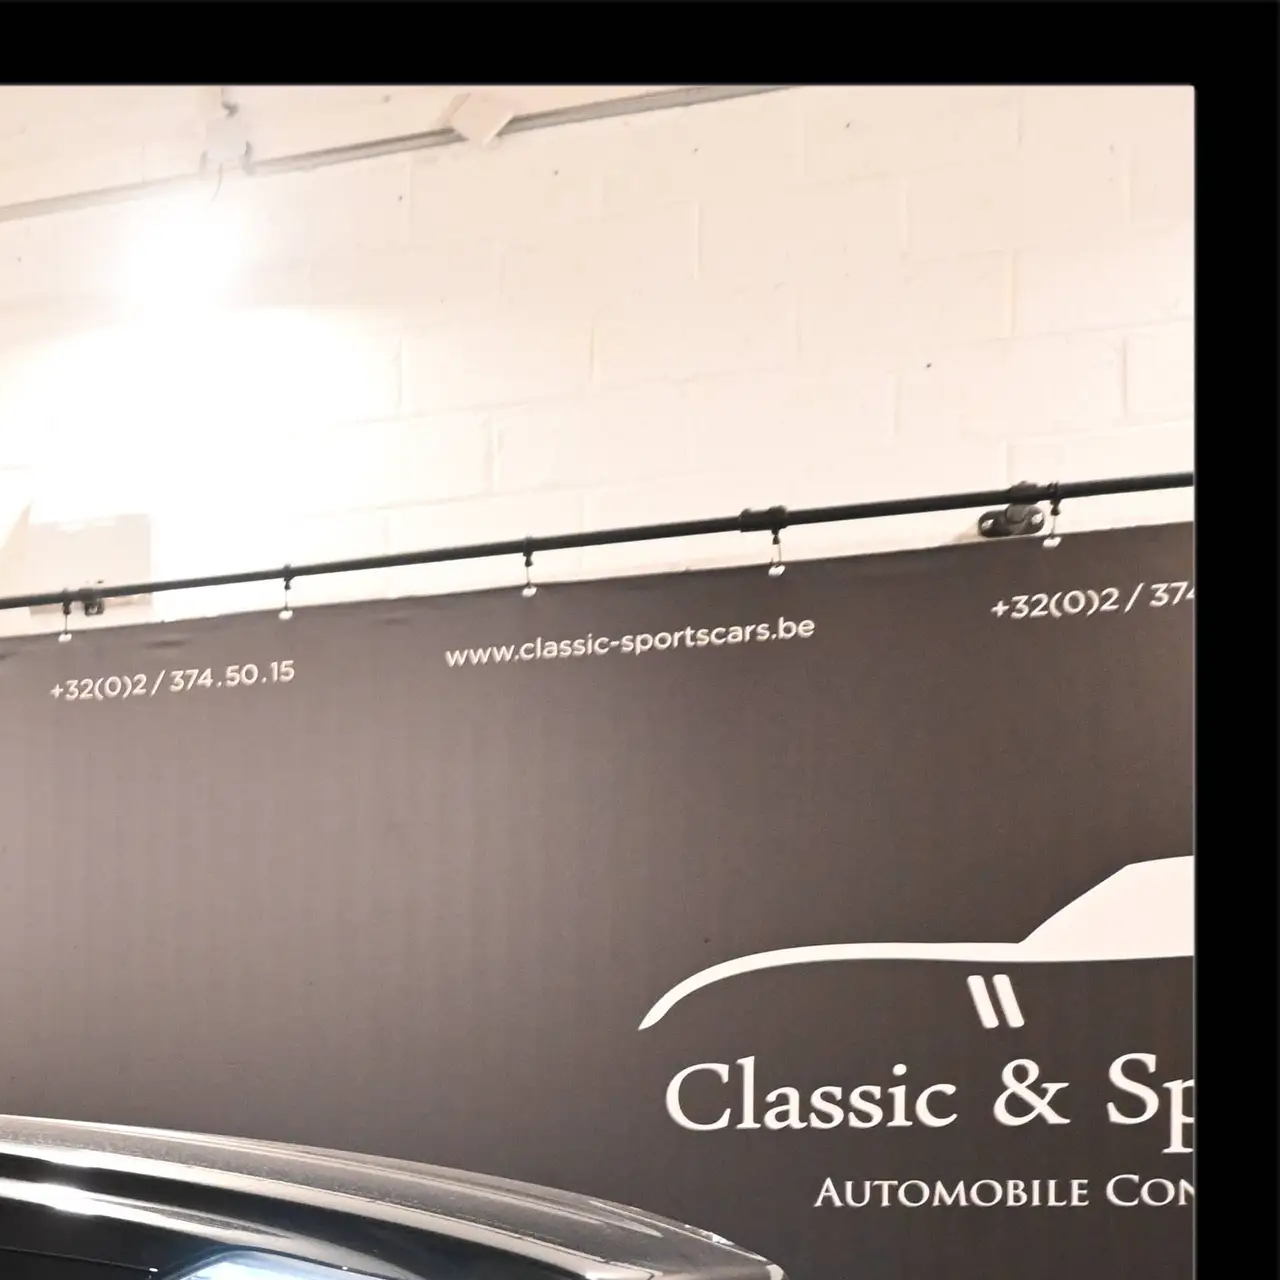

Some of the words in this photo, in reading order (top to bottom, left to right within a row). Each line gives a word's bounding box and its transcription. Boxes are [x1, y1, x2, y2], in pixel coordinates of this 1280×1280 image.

[990, 588, 1120, 620] +32(0)2
[445, 616, 816, 669] www.classic-sportscars.be
[50, 673, 147, 701] +32(0)2
[169, 659, 295, 692] 374.50.15
[664, 1055, 959, 1132] Classic
[992, 1058, 1072, 1127] &
[813, 1176, 1090, 1208] AUTOMOBILE
